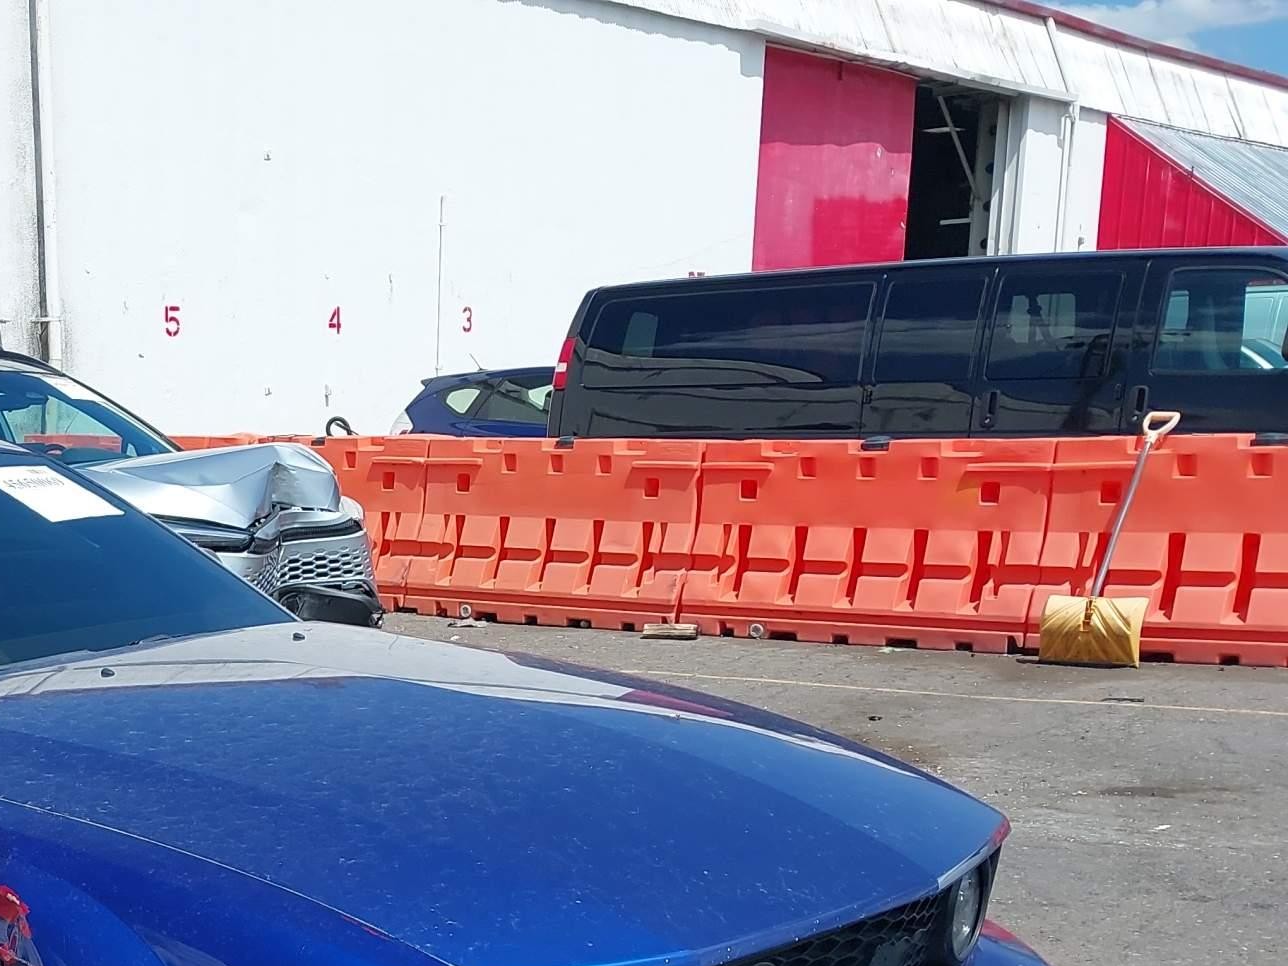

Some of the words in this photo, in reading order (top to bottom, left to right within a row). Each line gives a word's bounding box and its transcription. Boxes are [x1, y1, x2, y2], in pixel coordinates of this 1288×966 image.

[165, 306, 180, 337] 5
[328, 307, 342, 334] 4
[462, 307, 472, 333] 3
